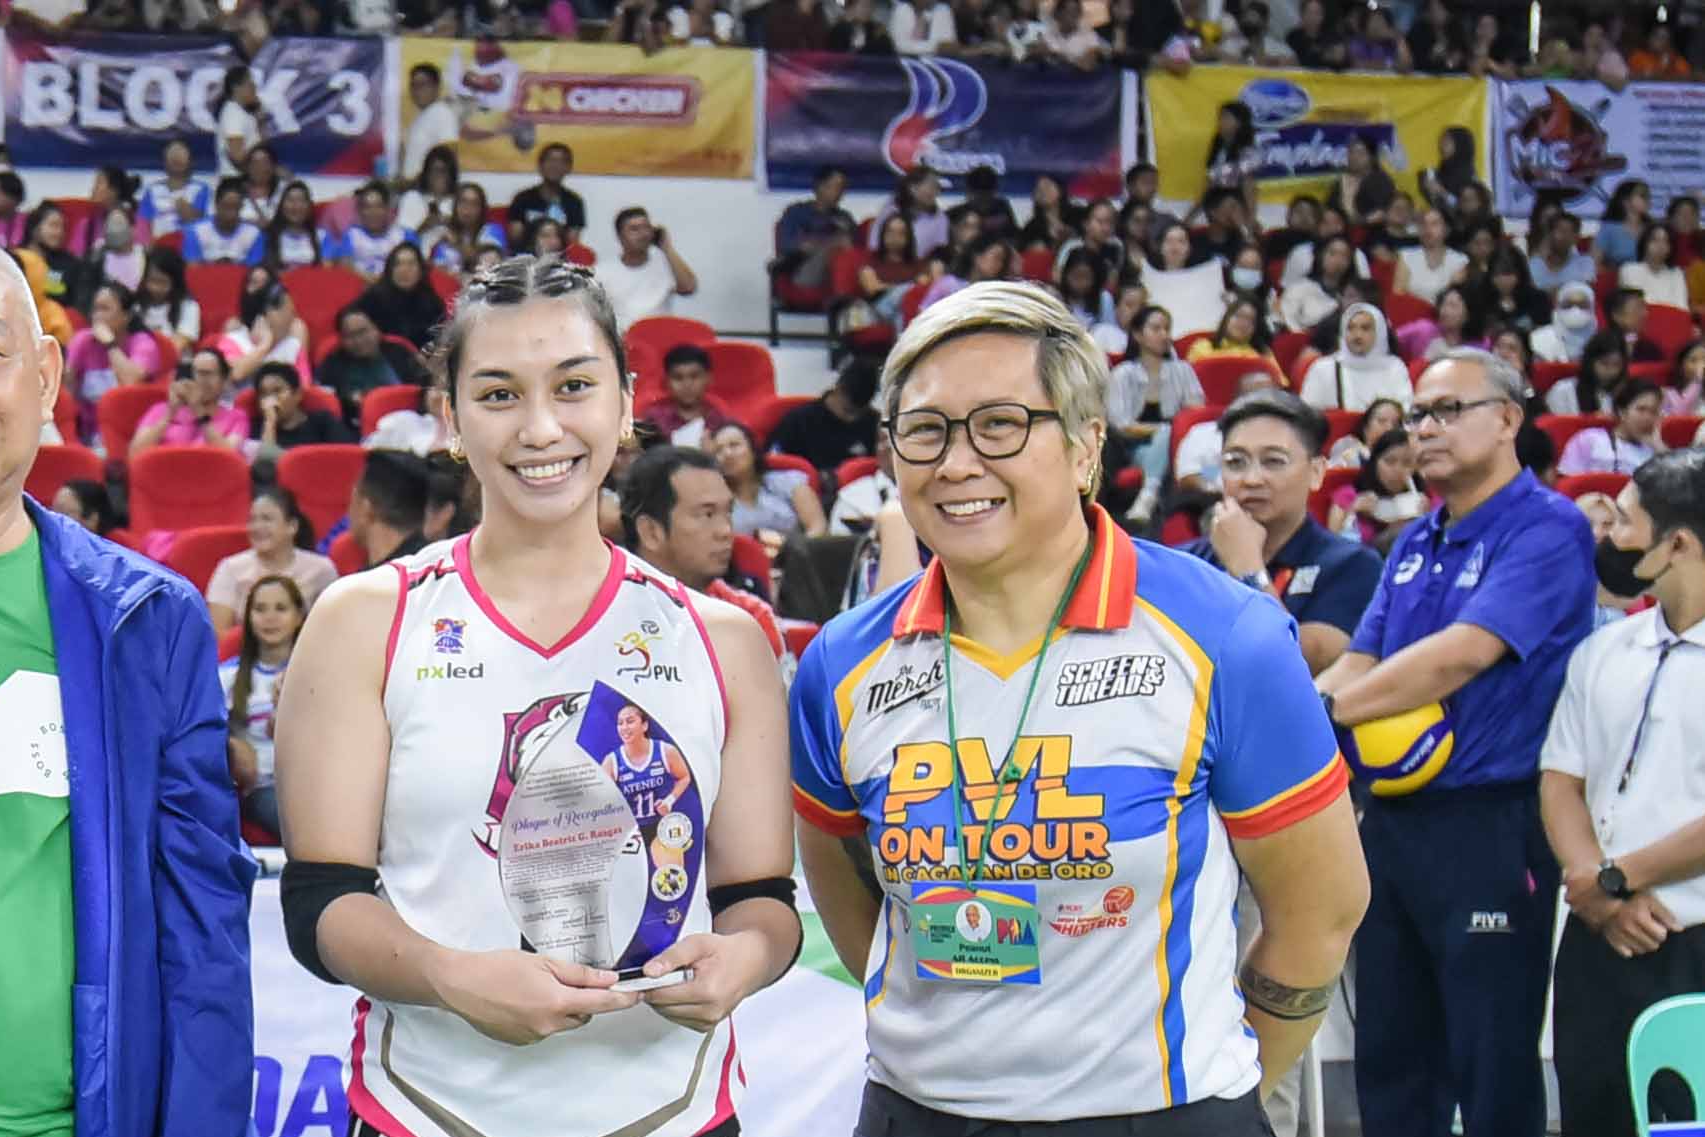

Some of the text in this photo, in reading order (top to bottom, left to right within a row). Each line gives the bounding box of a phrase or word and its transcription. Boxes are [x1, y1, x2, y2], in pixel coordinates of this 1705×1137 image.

[19, 60, 374, 136] BLOCK 3
[416, 662, 484, 681] nxled
[654, 664, 683, 684] PVL
[1061, 657, 1163, 684] SCREENS
[866, 659, 944, 715] Merch
[1056, 676, 1156, 706] THREADS
[622, 775, 665, 795] ATENEO
[882, 734, 1106, 825] PVL
[511, 803, 625, 834] Plaque of Recognition
[634, 791, 658, 818] 11
[879, 821, 1112, 864] ON TOUR
[901, 863, 1012, 883] CAGAYAN
[1016, 861, 1052, 880] DE
[1055, 859, 1114, 880] ORO
